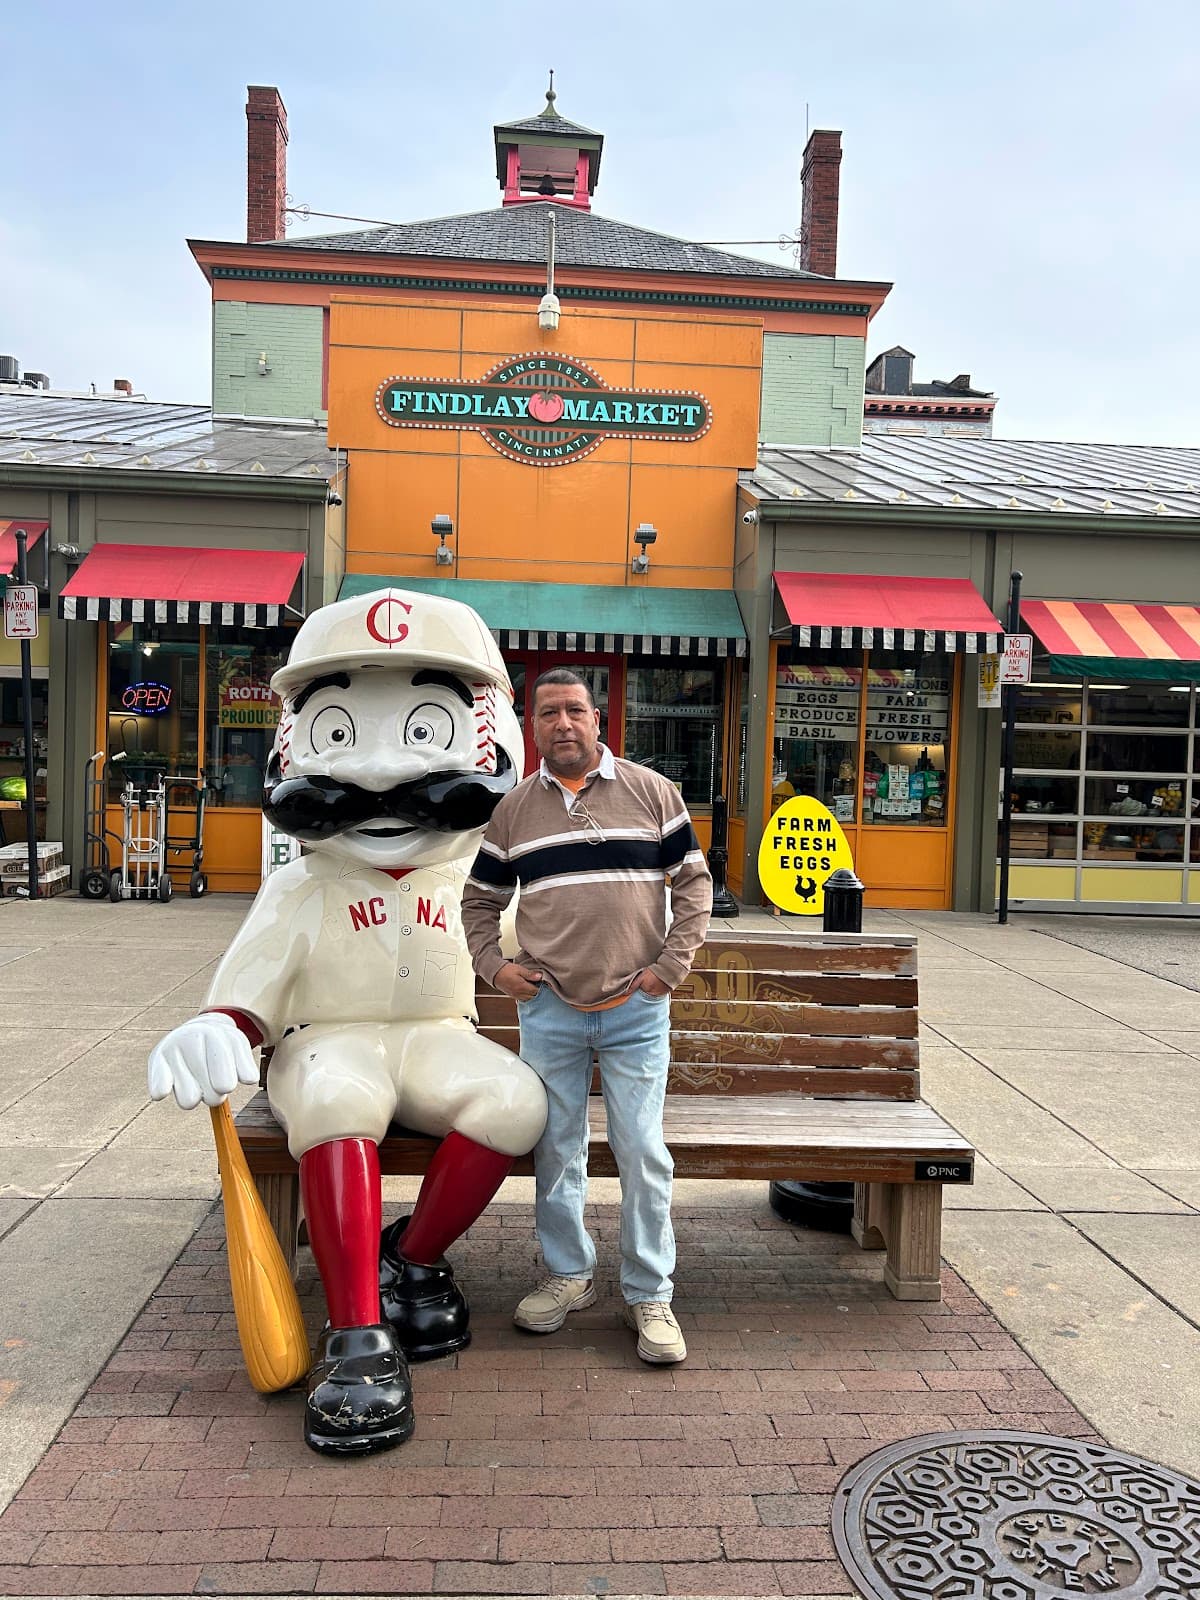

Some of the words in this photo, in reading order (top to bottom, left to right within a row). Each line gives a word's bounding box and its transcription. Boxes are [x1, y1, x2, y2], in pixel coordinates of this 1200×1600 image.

[500, 360, 547, 382] SINCE
[558, 363, 590, 386] 1852
[391, 389, 531, 418] FINDLAY
[561, 398, 700, 427] MARKET
[499, 431, 588, 457] CINCINNATI
[14, 591, 26, 601] NO
[6, 601, 35, 611] PARKING
[1009, 639, 1021, 649] NO
[1003, 649, 1029, 658] ARKING
[785, 673, 816, 685] NON
[122, 689, 172, 707] OPEN
[229, 686, 273, 700] ROTH
[796, 692, 838, 704] EGGS
[886, 695, 928, 707] FARM
[221, 709, 280, 724] PRODUCE
[779, 708, 856, 722] PRODUCE
[878, 712, 932, 725] FRESH
[789, 726, 836, 739] BASIL
[865, 729, 942, 743] FLOWERS
[778, 817, 831, 832] FARM
[773, 836, 836, 851] FRESH
[780, 856, 831, 870] EGGS
[938, 1167, 960, 1177] PNC
